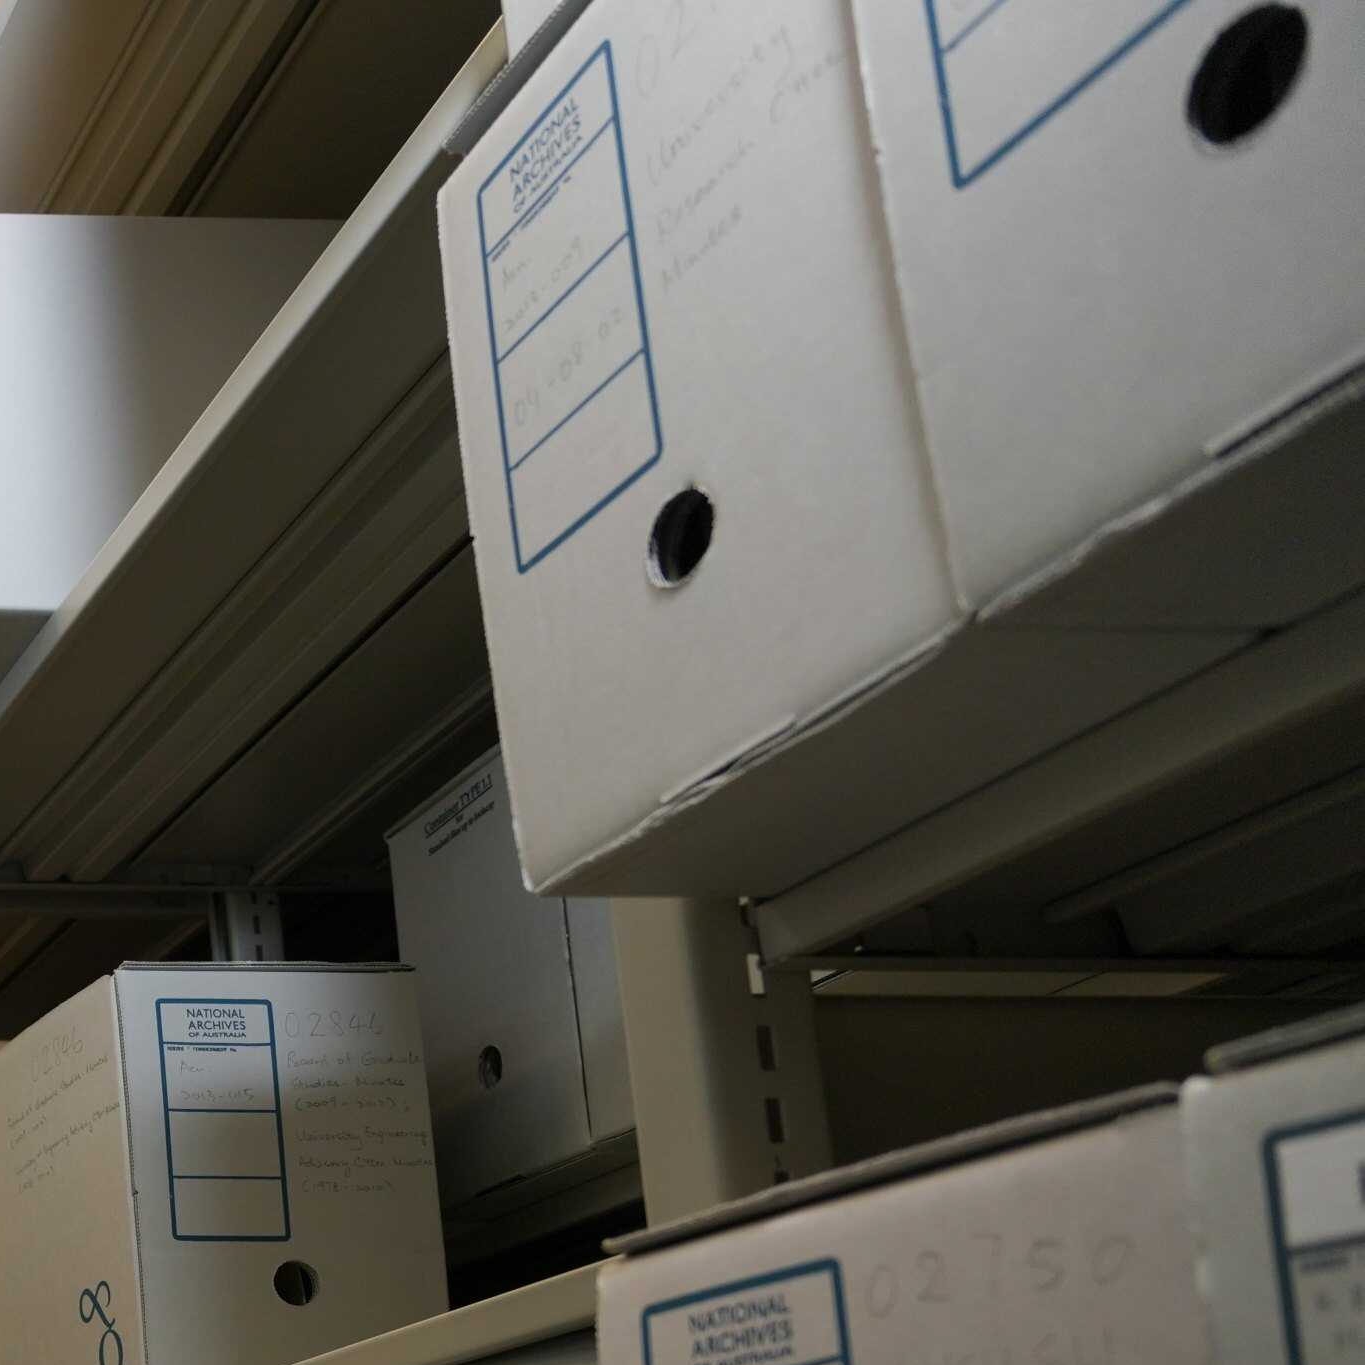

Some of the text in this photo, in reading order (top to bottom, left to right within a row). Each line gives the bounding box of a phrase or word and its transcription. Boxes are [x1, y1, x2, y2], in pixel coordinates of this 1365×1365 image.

[509, 97, 581, 184] NATIONAL
[512, 114, 583, 203] ARCHIVES
[186, 1008, 245, 1018] NATIONAL
[188, 1020, 247, 1031] ARCHIVES
[688, 1292, 793, 1335] NATIONAL
[690, 1318, 794, 1359] ARCHIVES
